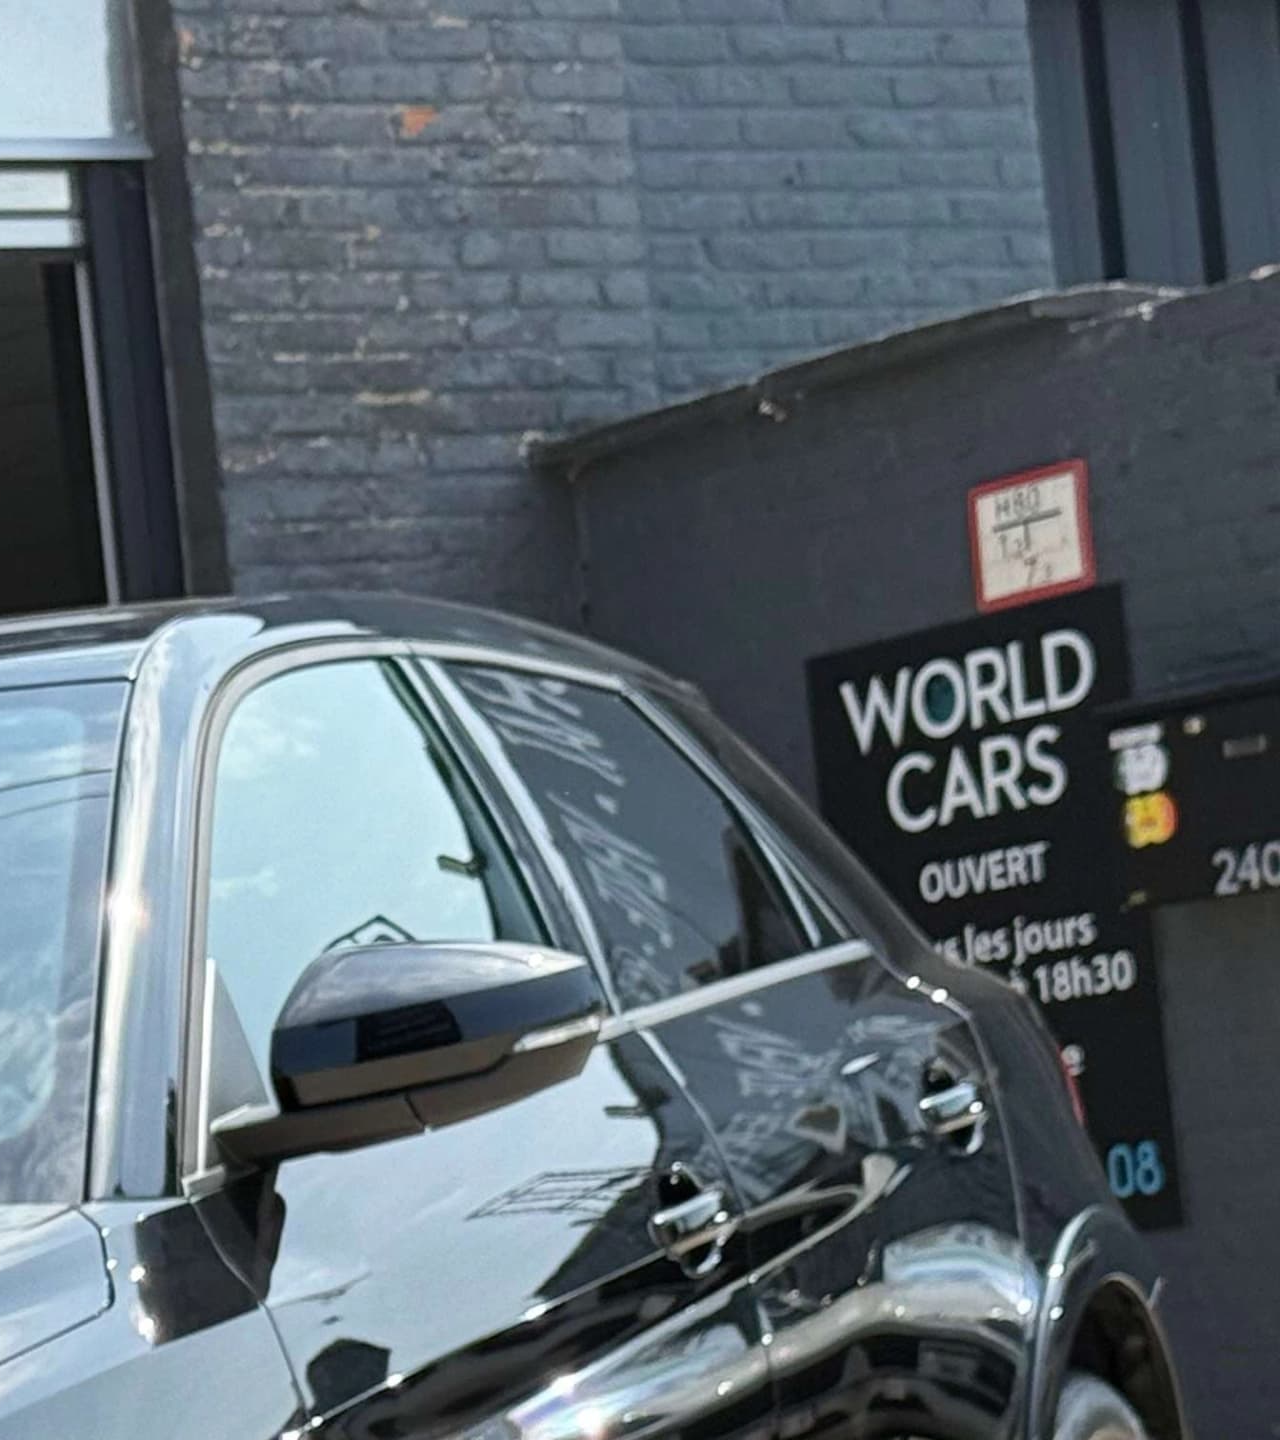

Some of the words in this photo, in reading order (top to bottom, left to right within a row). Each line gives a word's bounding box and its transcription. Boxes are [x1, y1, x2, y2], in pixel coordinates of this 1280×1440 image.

[840, 629, 1096, 755] WORLD
[886, 725, 1068, 834] CARS
[919, 840, 1051, 903] OUVERT
[964, 922, 1009, 967] les
[1013, 912, 1098, 966] jours
[1033, 950, 1137, 1004] 18h30
[1107, 1139, 1166, 1199] 08
